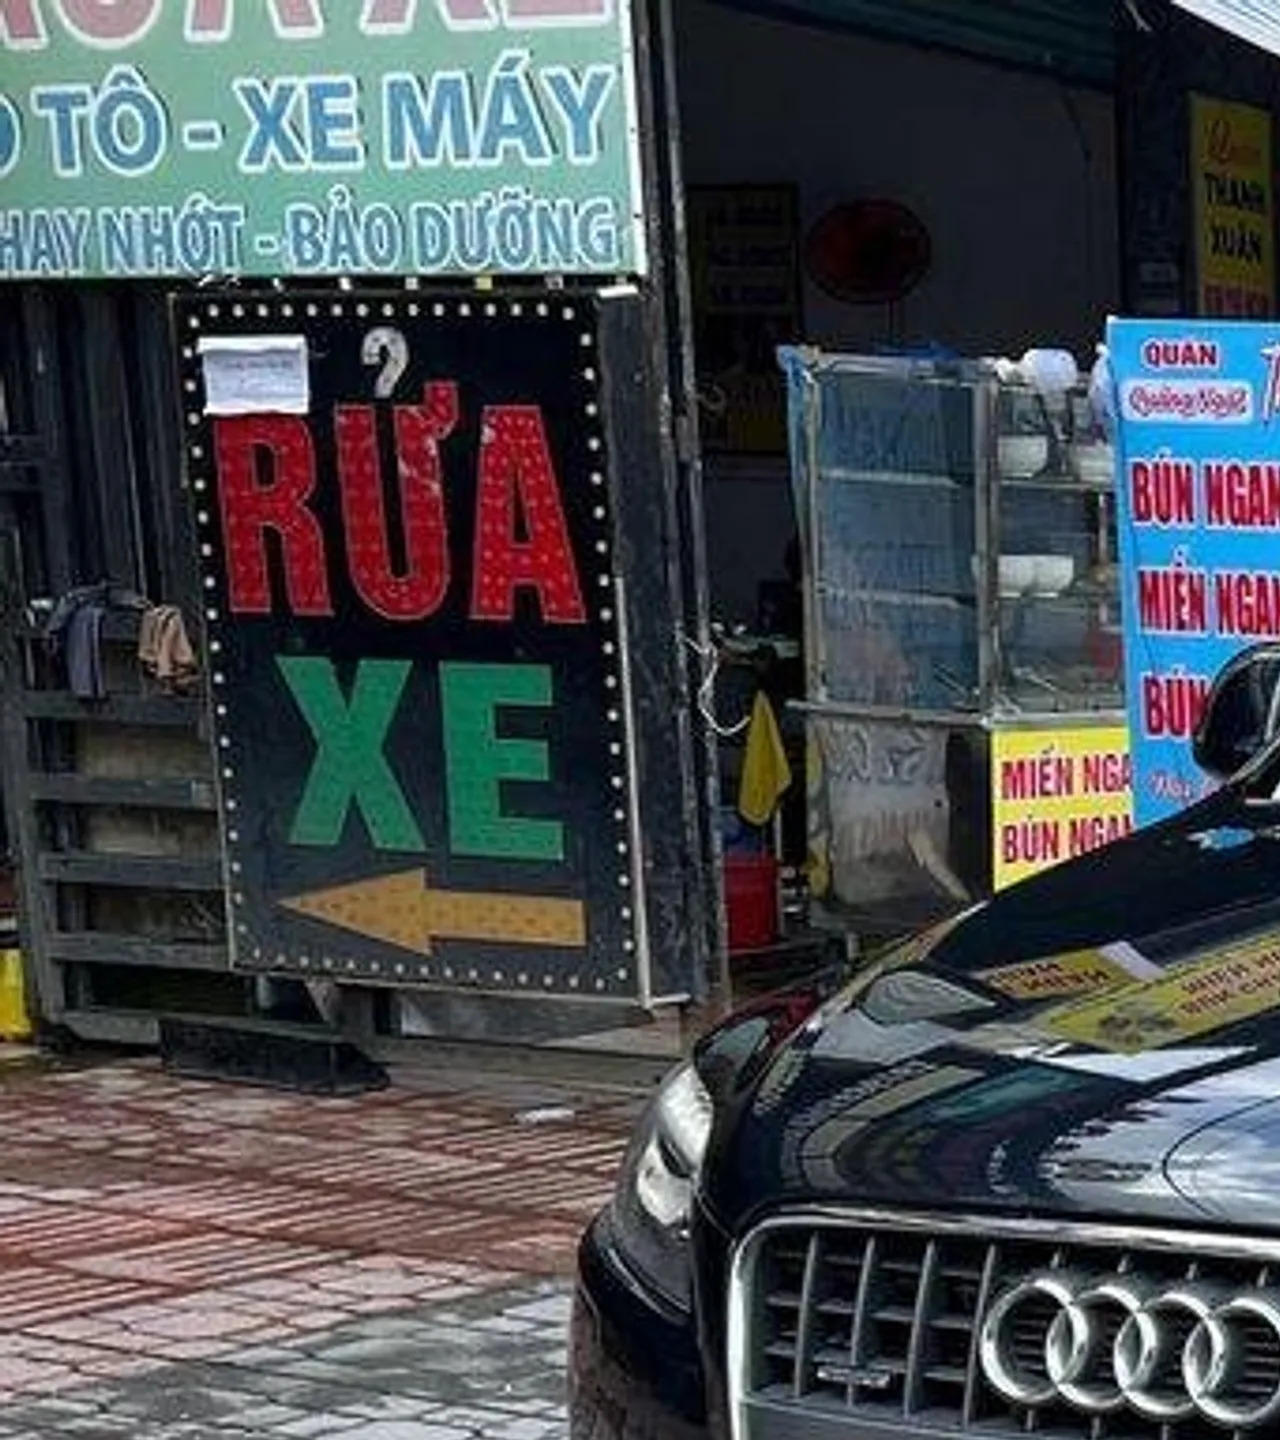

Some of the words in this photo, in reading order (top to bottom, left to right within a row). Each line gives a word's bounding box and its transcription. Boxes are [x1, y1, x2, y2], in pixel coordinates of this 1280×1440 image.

[33, 64, 168, 177] TÔ
[233, 76, 364, 172] XE
[381, 49, 616, 169] MÁY
[283, 184, 401, 273] BẢO
[213, 325, 588, 624] RỬA
[1130, 447, 1196, 526] BÚN
[274, 655, 565, 861] XE
[1003, 814, 1060, 864] BÚN
